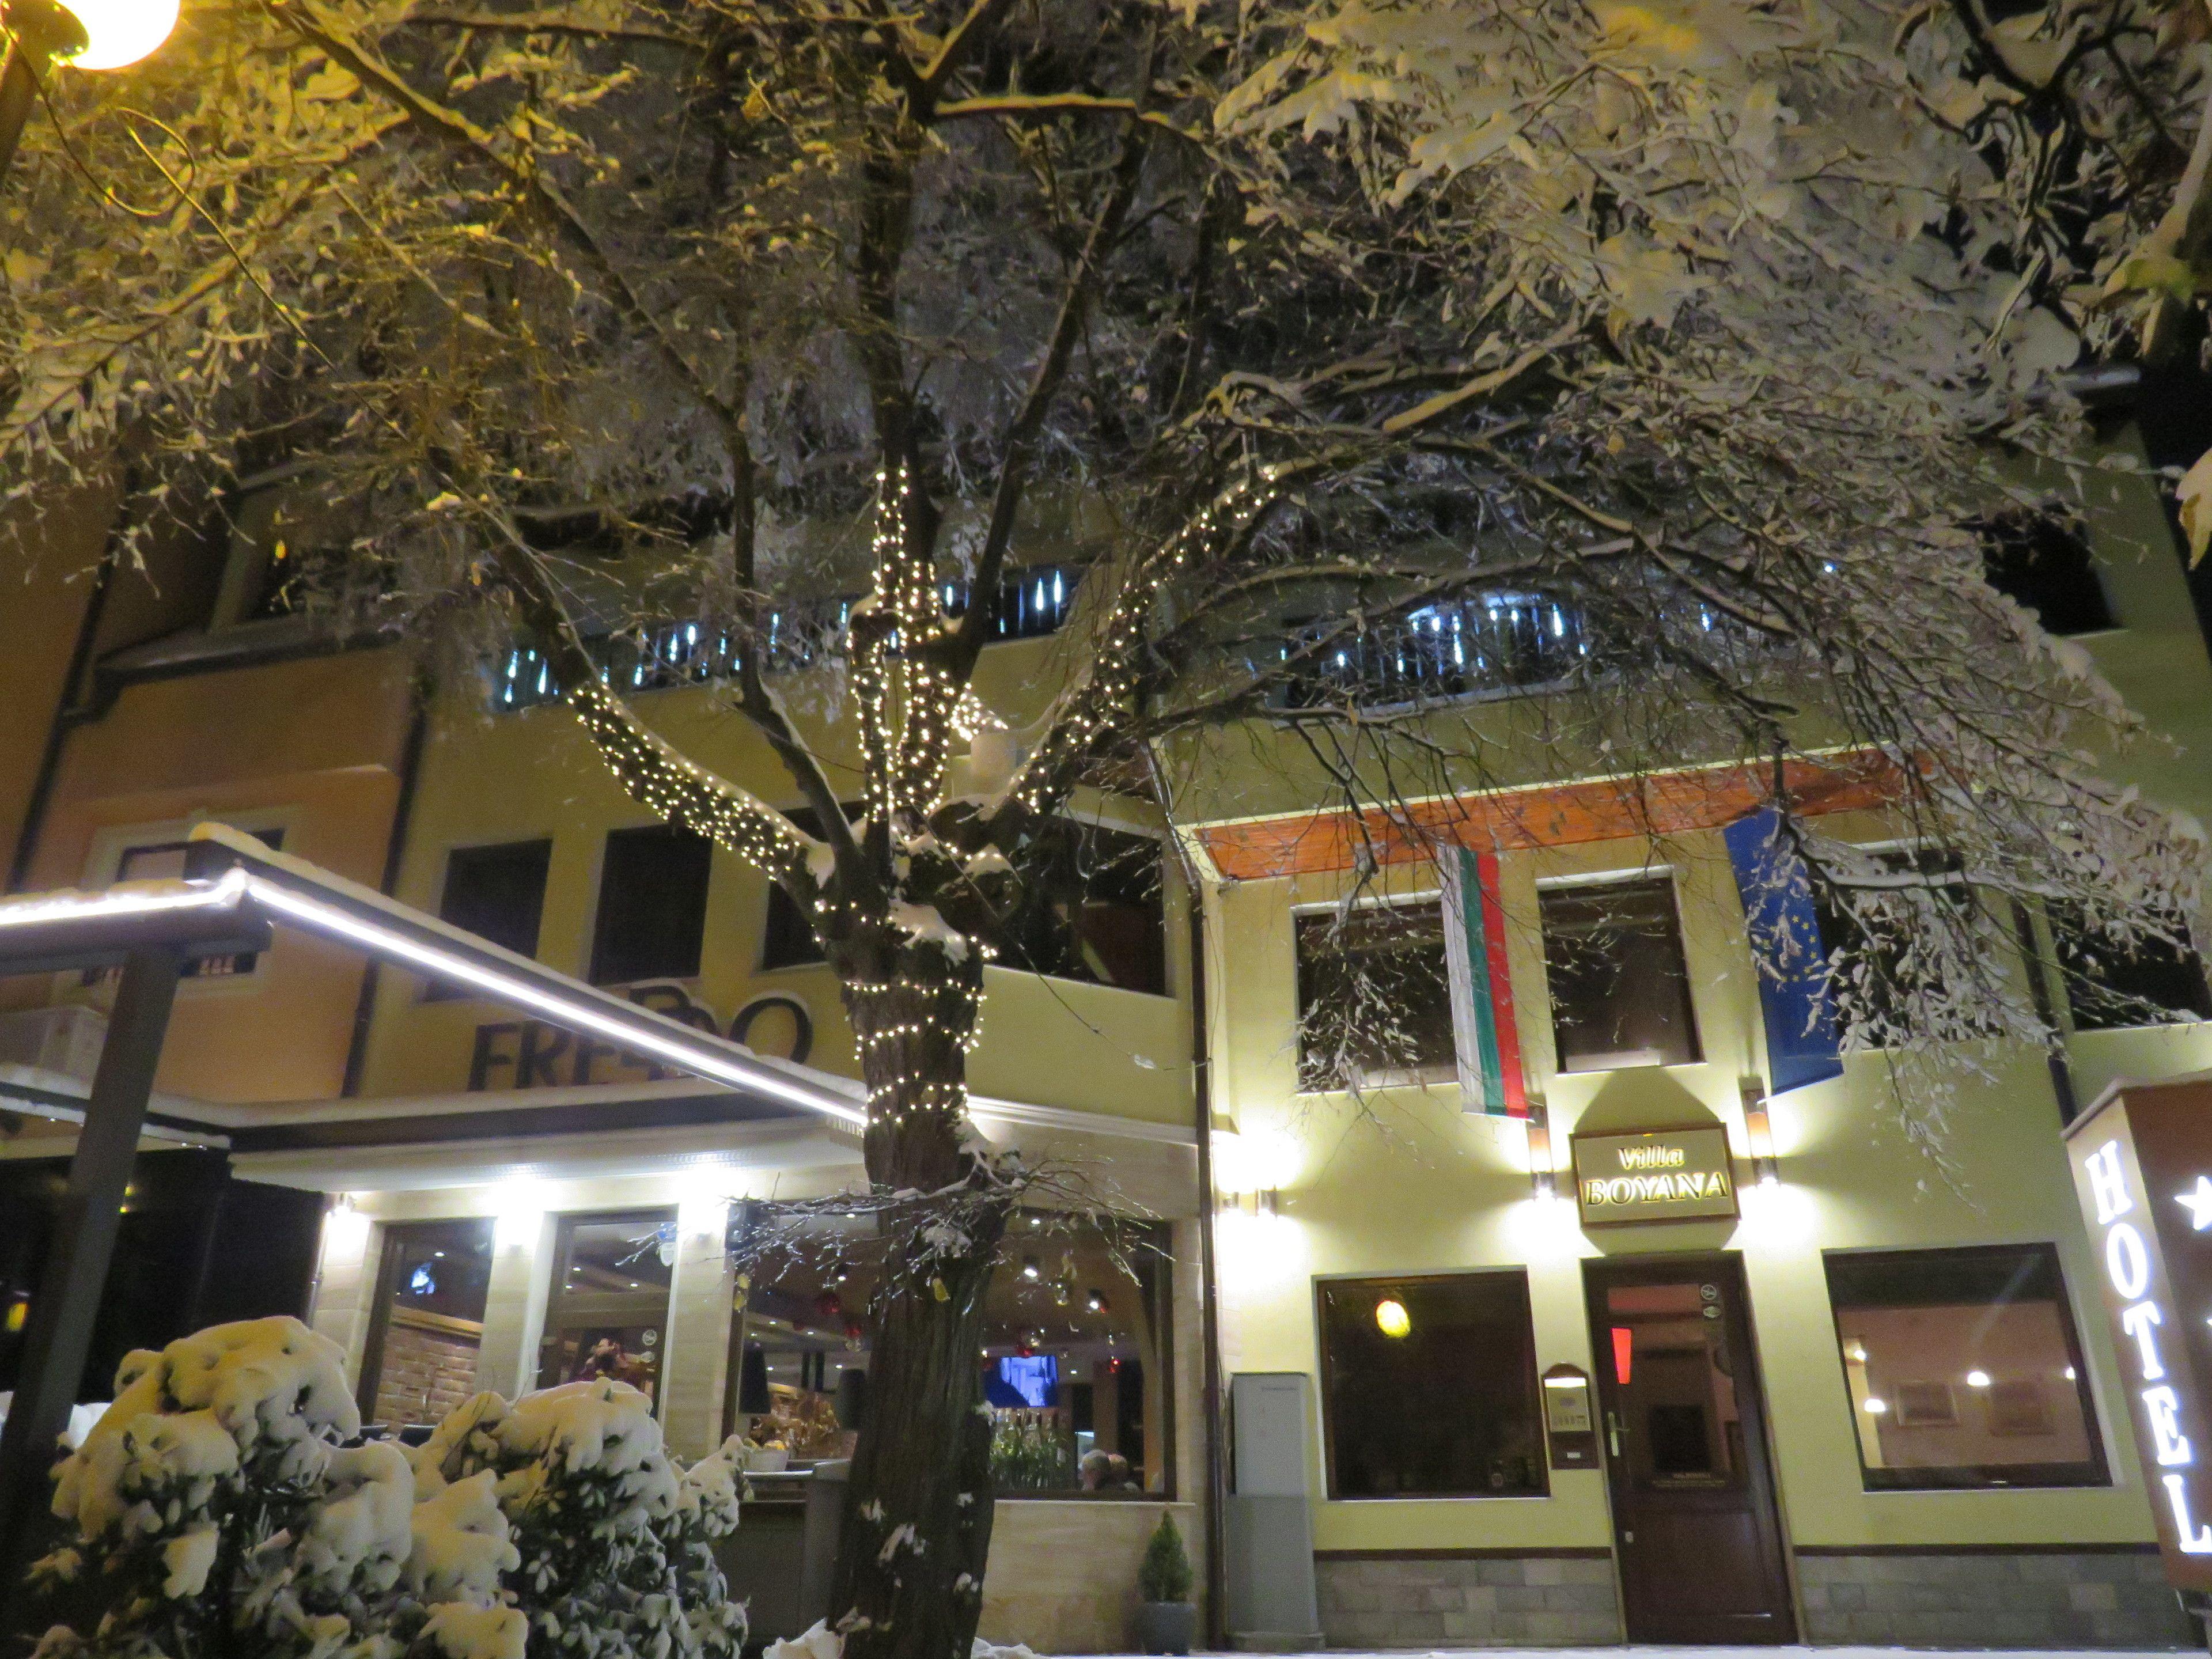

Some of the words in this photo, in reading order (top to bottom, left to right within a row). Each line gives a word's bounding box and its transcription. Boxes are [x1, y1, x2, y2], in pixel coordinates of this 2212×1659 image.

[1619, 1145, 1685, 1170] Villa
[1585, 1172, 1728, 1205] BOYANA
[2084, 1139, 2212, 1555] HOTEL
